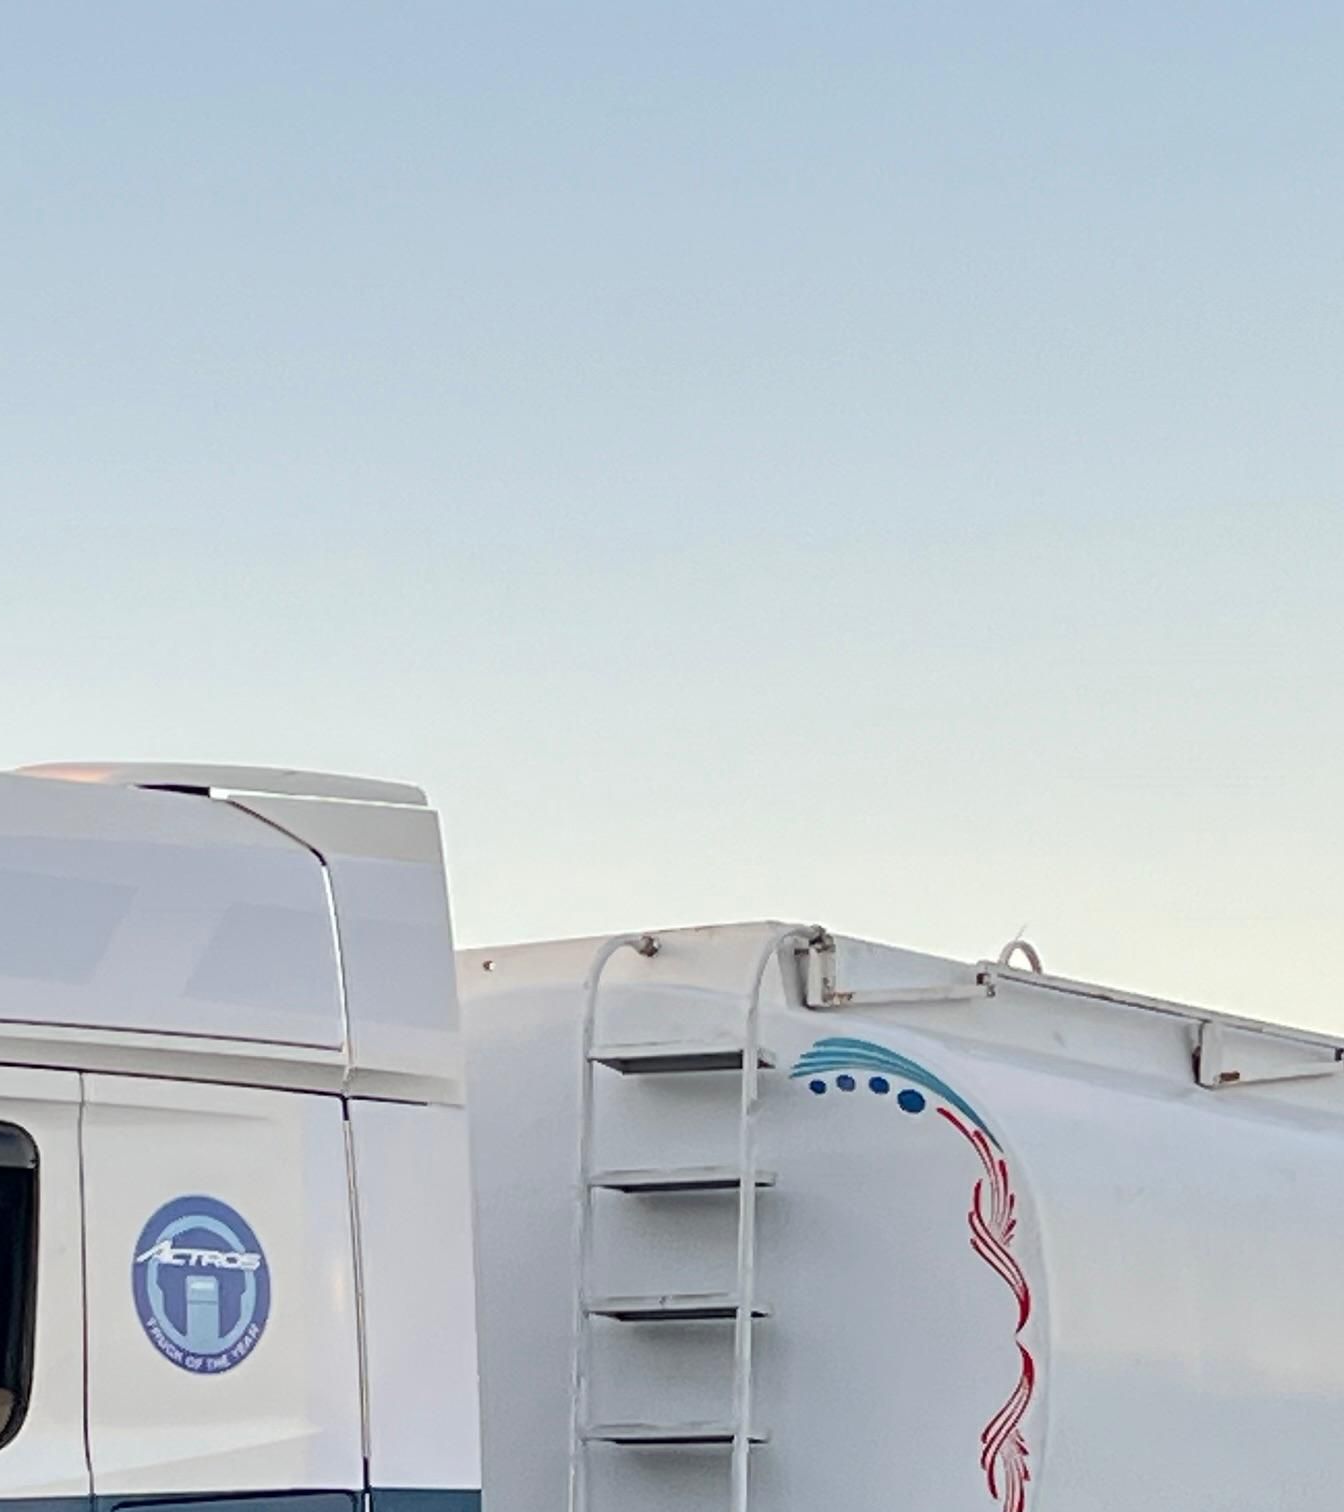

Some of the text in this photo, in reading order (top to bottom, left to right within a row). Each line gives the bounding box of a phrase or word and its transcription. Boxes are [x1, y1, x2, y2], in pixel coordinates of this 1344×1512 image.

[136, 1239, 262, 1271] ACTROS
[146, 1315, 261, 1372] TRUCK OF THE YEAR
